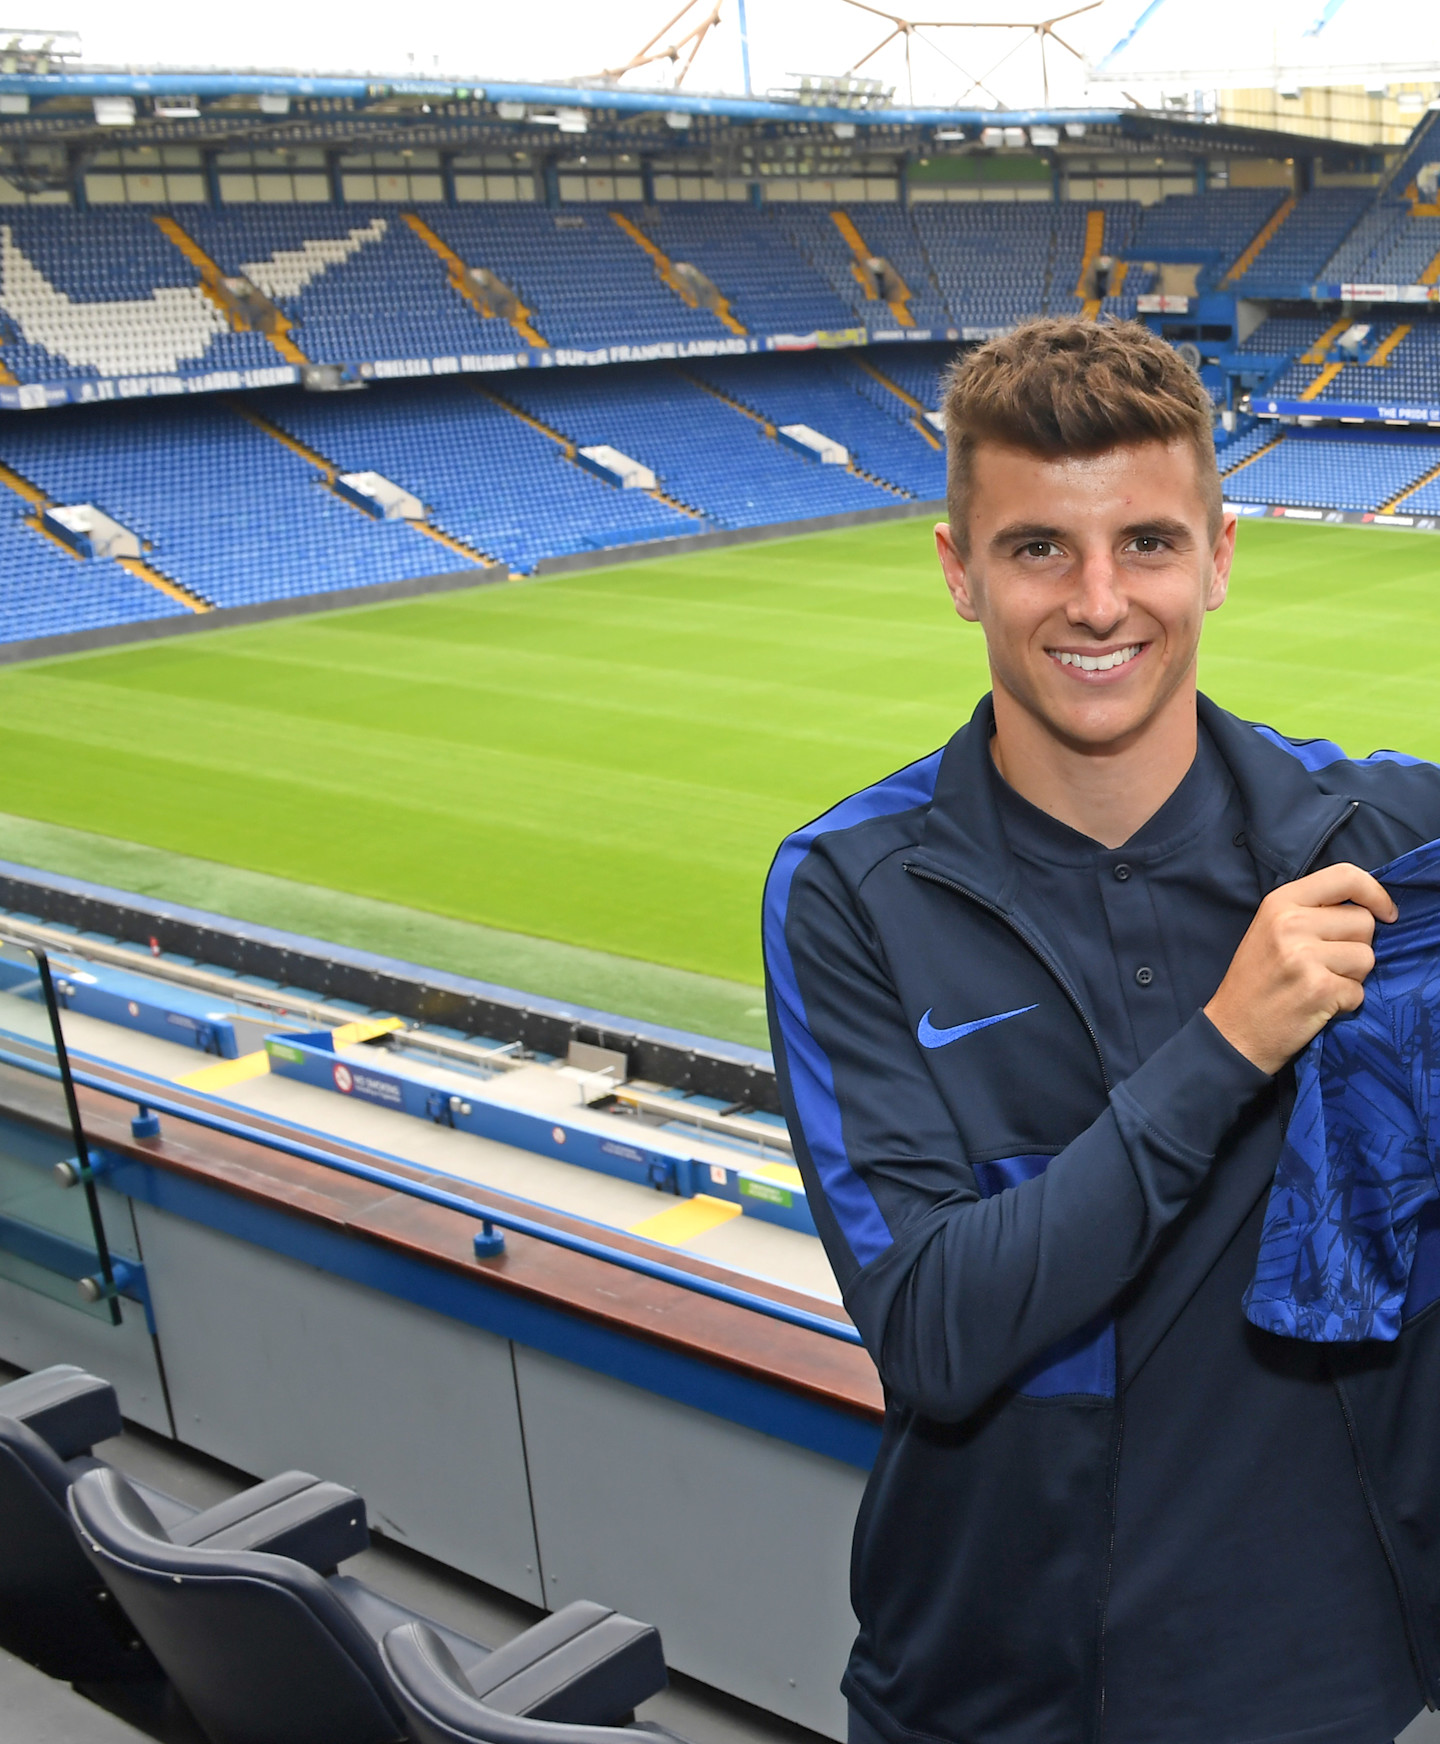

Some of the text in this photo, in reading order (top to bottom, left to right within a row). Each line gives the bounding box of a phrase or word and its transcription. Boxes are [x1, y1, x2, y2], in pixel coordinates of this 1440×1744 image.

[555, 349, 608, 365] SUPER
[678, 338, 747, 357] LAMPARD
[1377, 407, 1397, 419] THE
[1398, 408, 1428, 420] PRIDE
